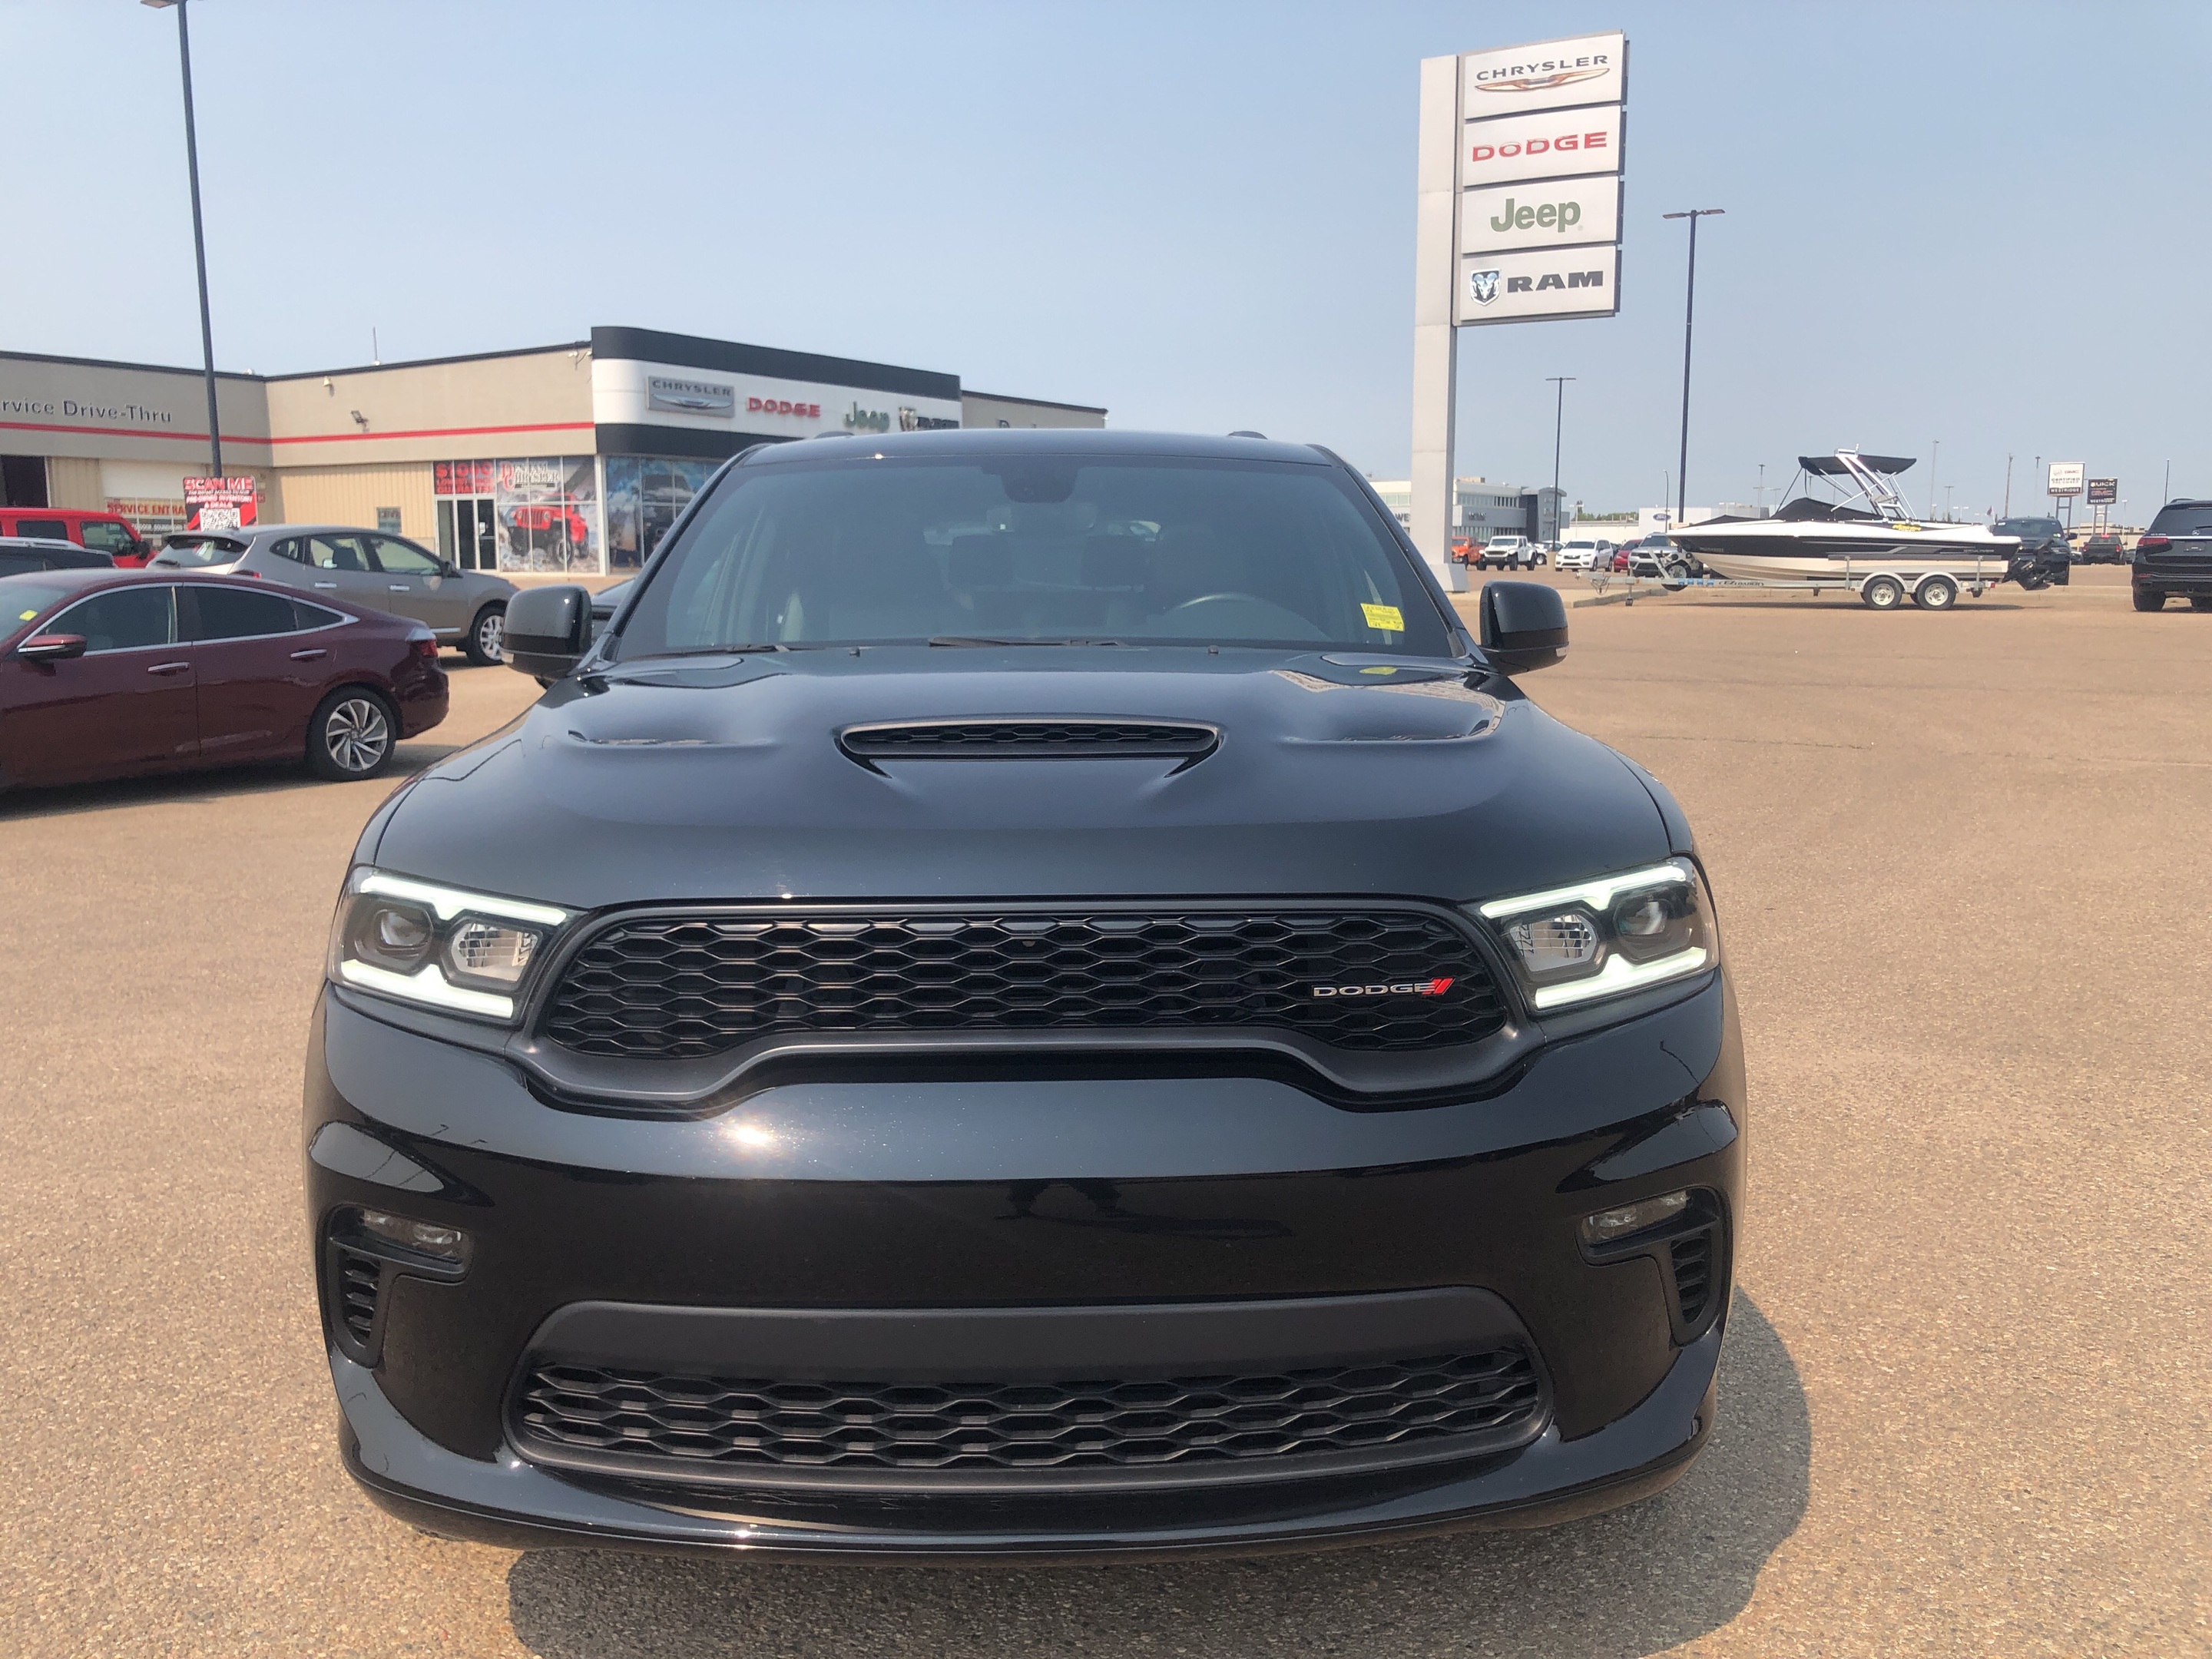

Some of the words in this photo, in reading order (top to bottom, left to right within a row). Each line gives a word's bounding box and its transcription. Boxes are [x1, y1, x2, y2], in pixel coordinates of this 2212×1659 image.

[1476, 55, 1608, 81] CHRYSLER
[1472, 131, 1608, 162] DODGE
[1490, 197, 1581, 233] Jeep
[1507, 270, 1604, 293] RAM
[653, 380, 730, 397] CHRYSLER
[63, 399, 172, 422] Drive-Thru
[748, 396, 821, 418] DODGE
[844, 400, 890, 432] Jeep
[184, 477, 225, 490] SCAN
[227, 477, 253, 490] ME
[107, 502, 149, 515] SERVICE
[1313, 983, 1435, 997] DODGE
